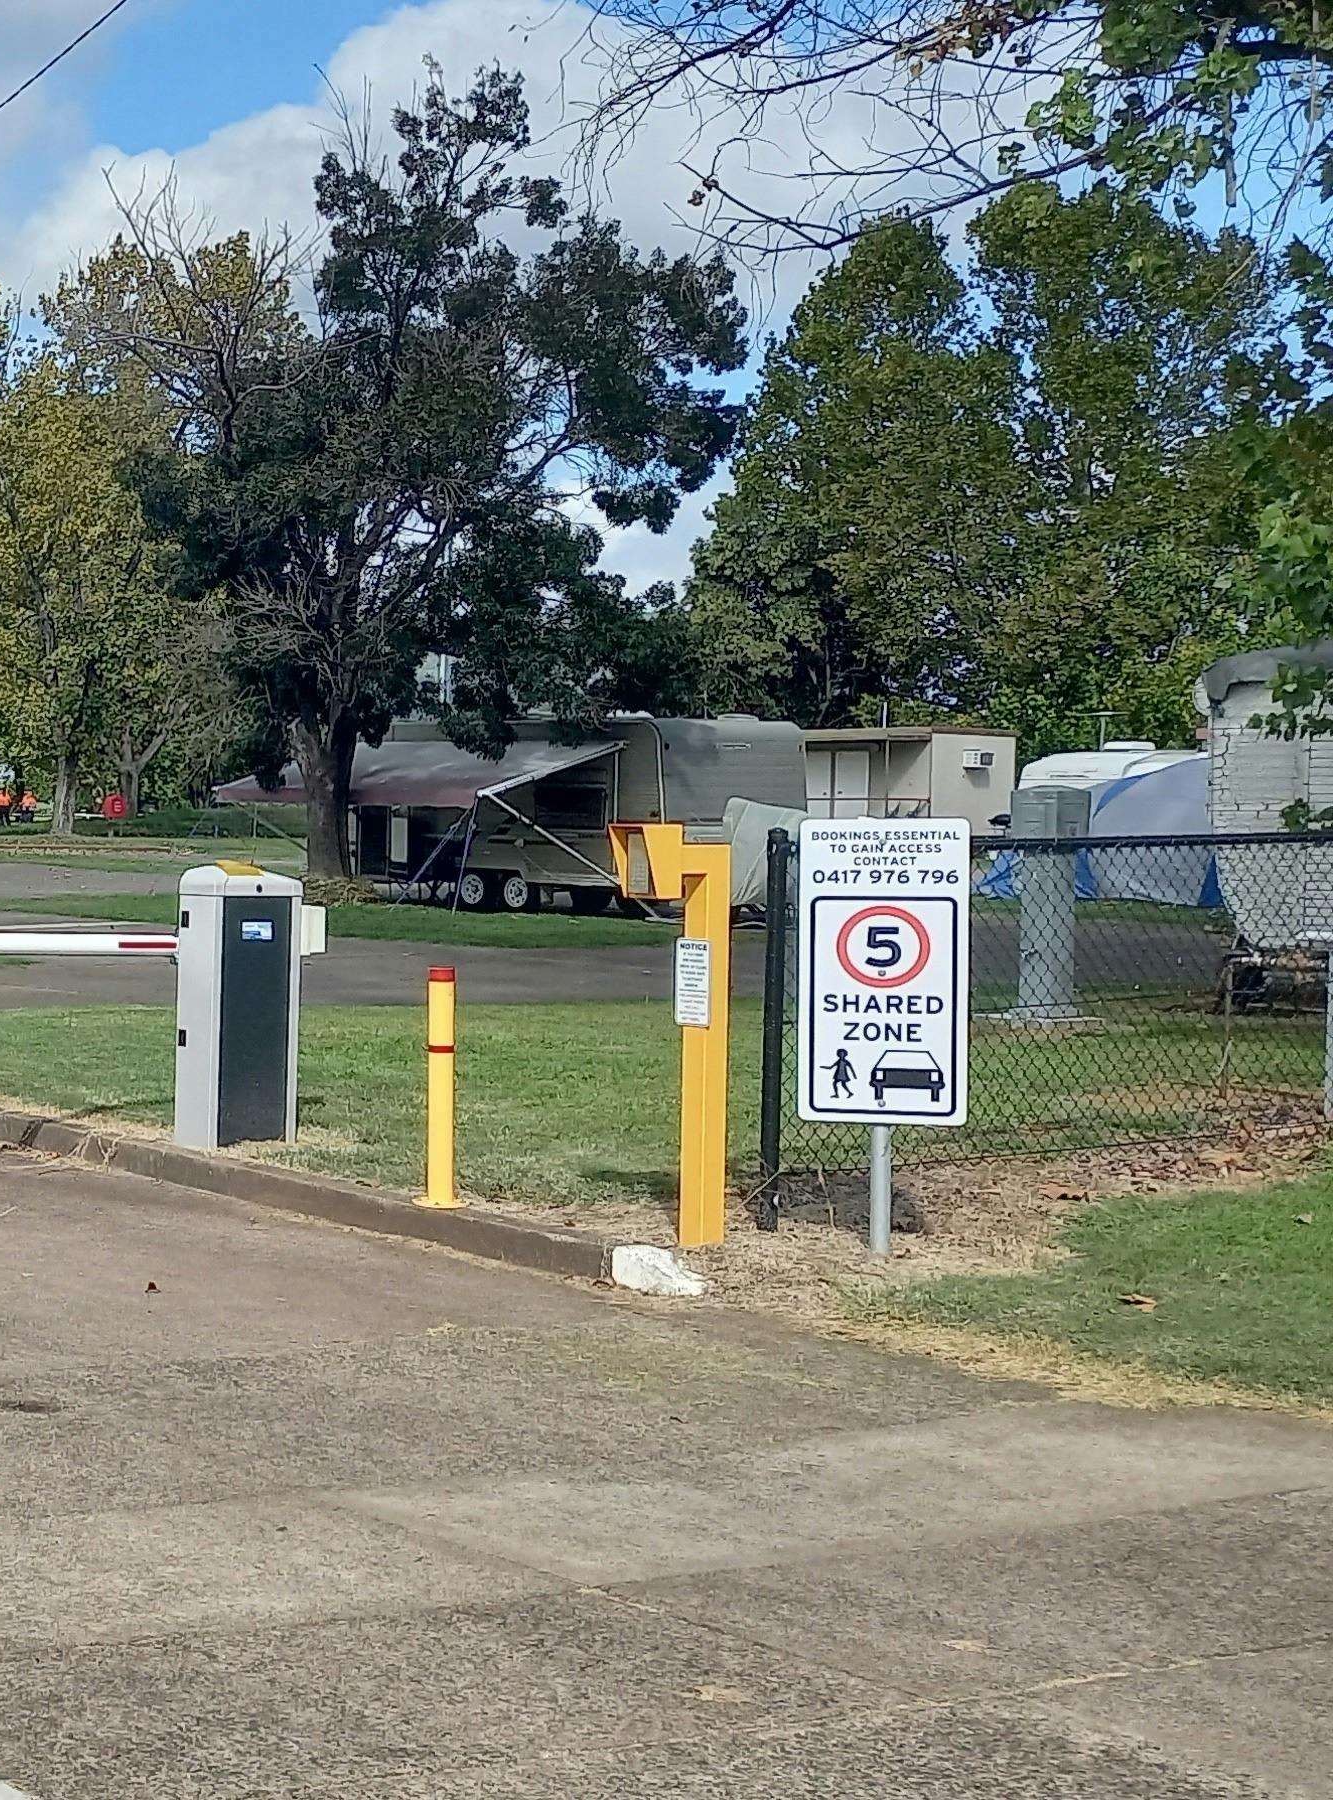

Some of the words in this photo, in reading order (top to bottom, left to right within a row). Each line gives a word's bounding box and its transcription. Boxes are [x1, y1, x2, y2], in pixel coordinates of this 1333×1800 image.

[811, 831, 879, 841] BOOKINGS
[885, 831, 960, 840] ESSENTIAL
[830, 844, 846, 853] TO
[851, 843, 883, 853] GAIN
[889, 844, 942, 853] ACCESS
[853, 856, 917, 866] CONTACT
[813, 869, 861, 884] 0417
[869, 869, 910, 884] 976
[918, 869, 959, 884] 796
[680, 943, 708, 951] NOTICE
[865, 926, 901, 968] 5
[823, 994, 944, 1014] SHARED
[843, 1023, 922, 1042] ZONE
